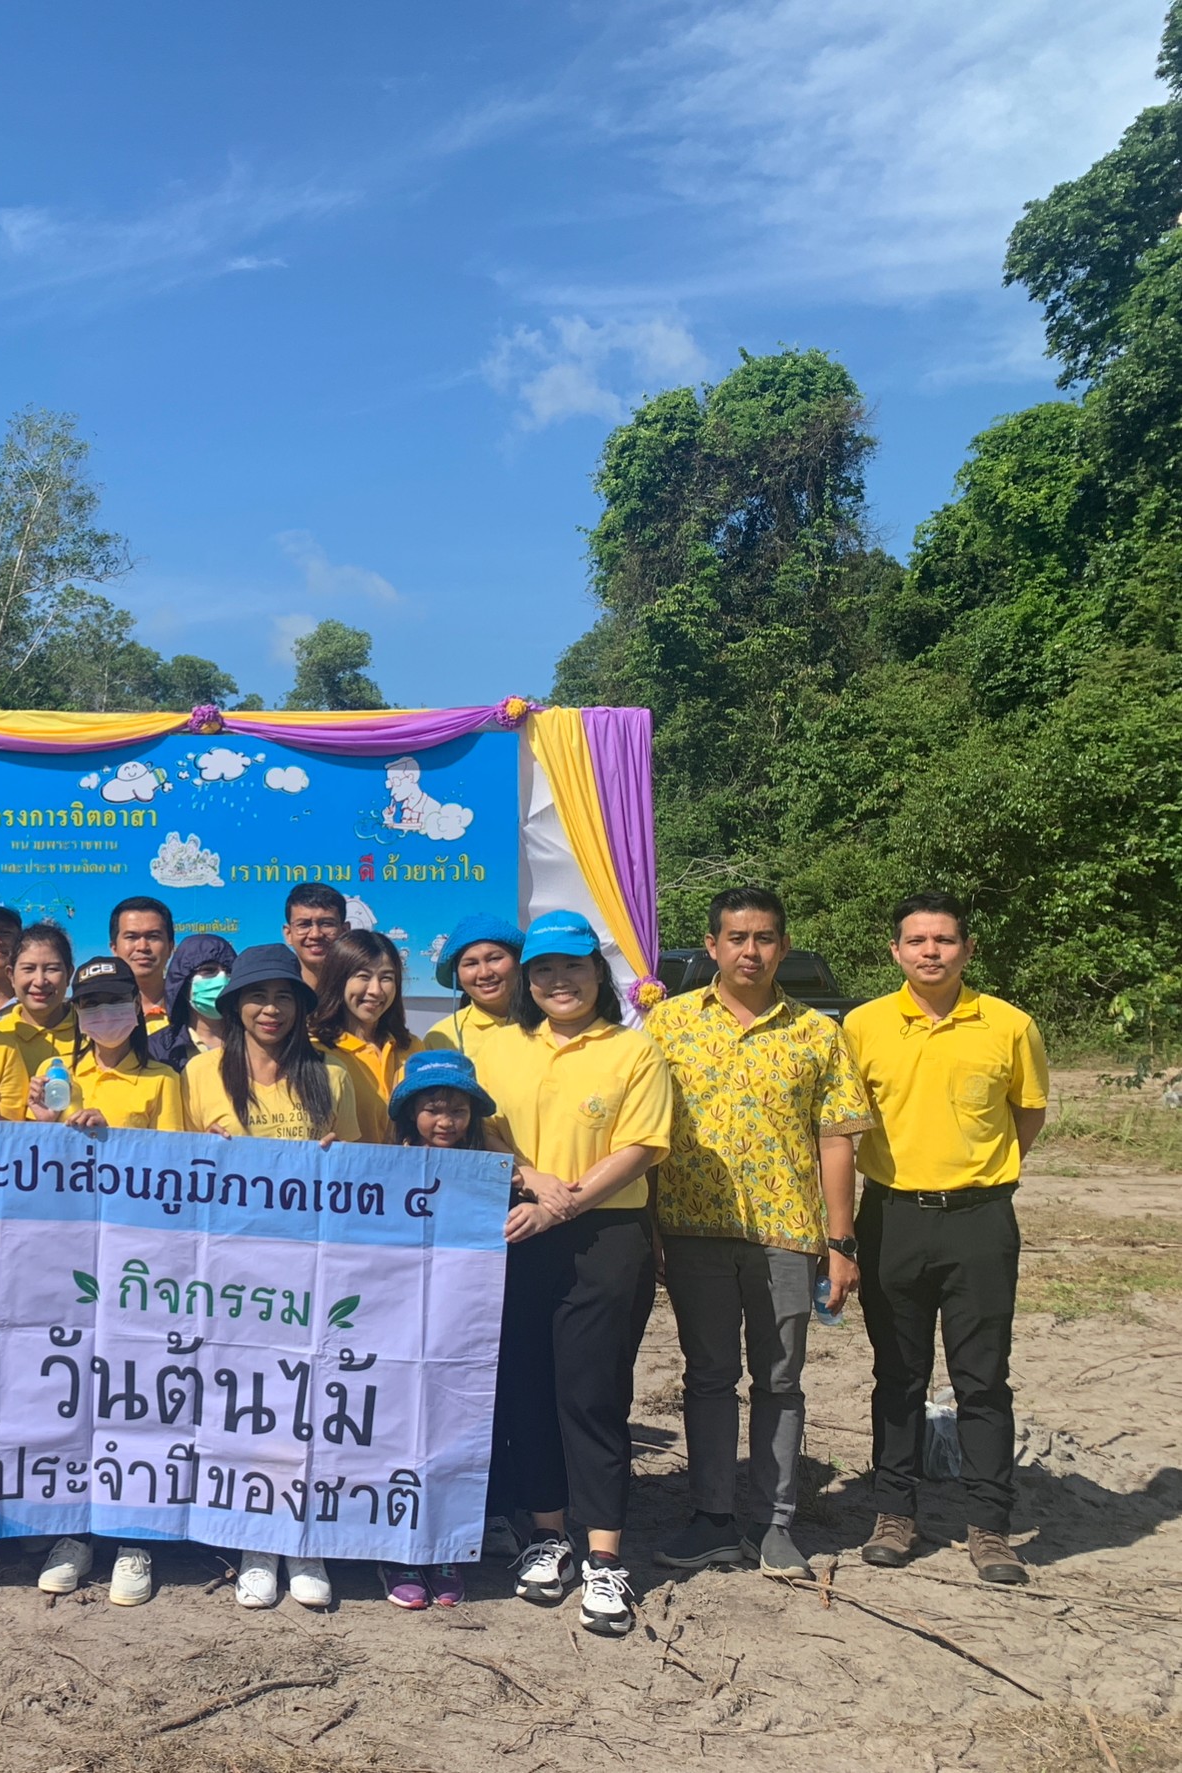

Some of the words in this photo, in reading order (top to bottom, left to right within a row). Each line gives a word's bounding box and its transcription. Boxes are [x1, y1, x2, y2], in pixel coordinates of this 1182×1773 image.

[231, 857, 351, 882] เราทำความ
[358, 854, 375, 882] ดี
[382, 853, 486, 882] ด้วยหัวใจ
[80, 963, 114, 979] JCB
[276, 1126, 304, 1138] SINCE
[404, 1178, 441, 1218] ๔
[119, 1260, 310, 1326] กิจกรรม
[40, 1326, 378, 1447] วันต้นไม้
